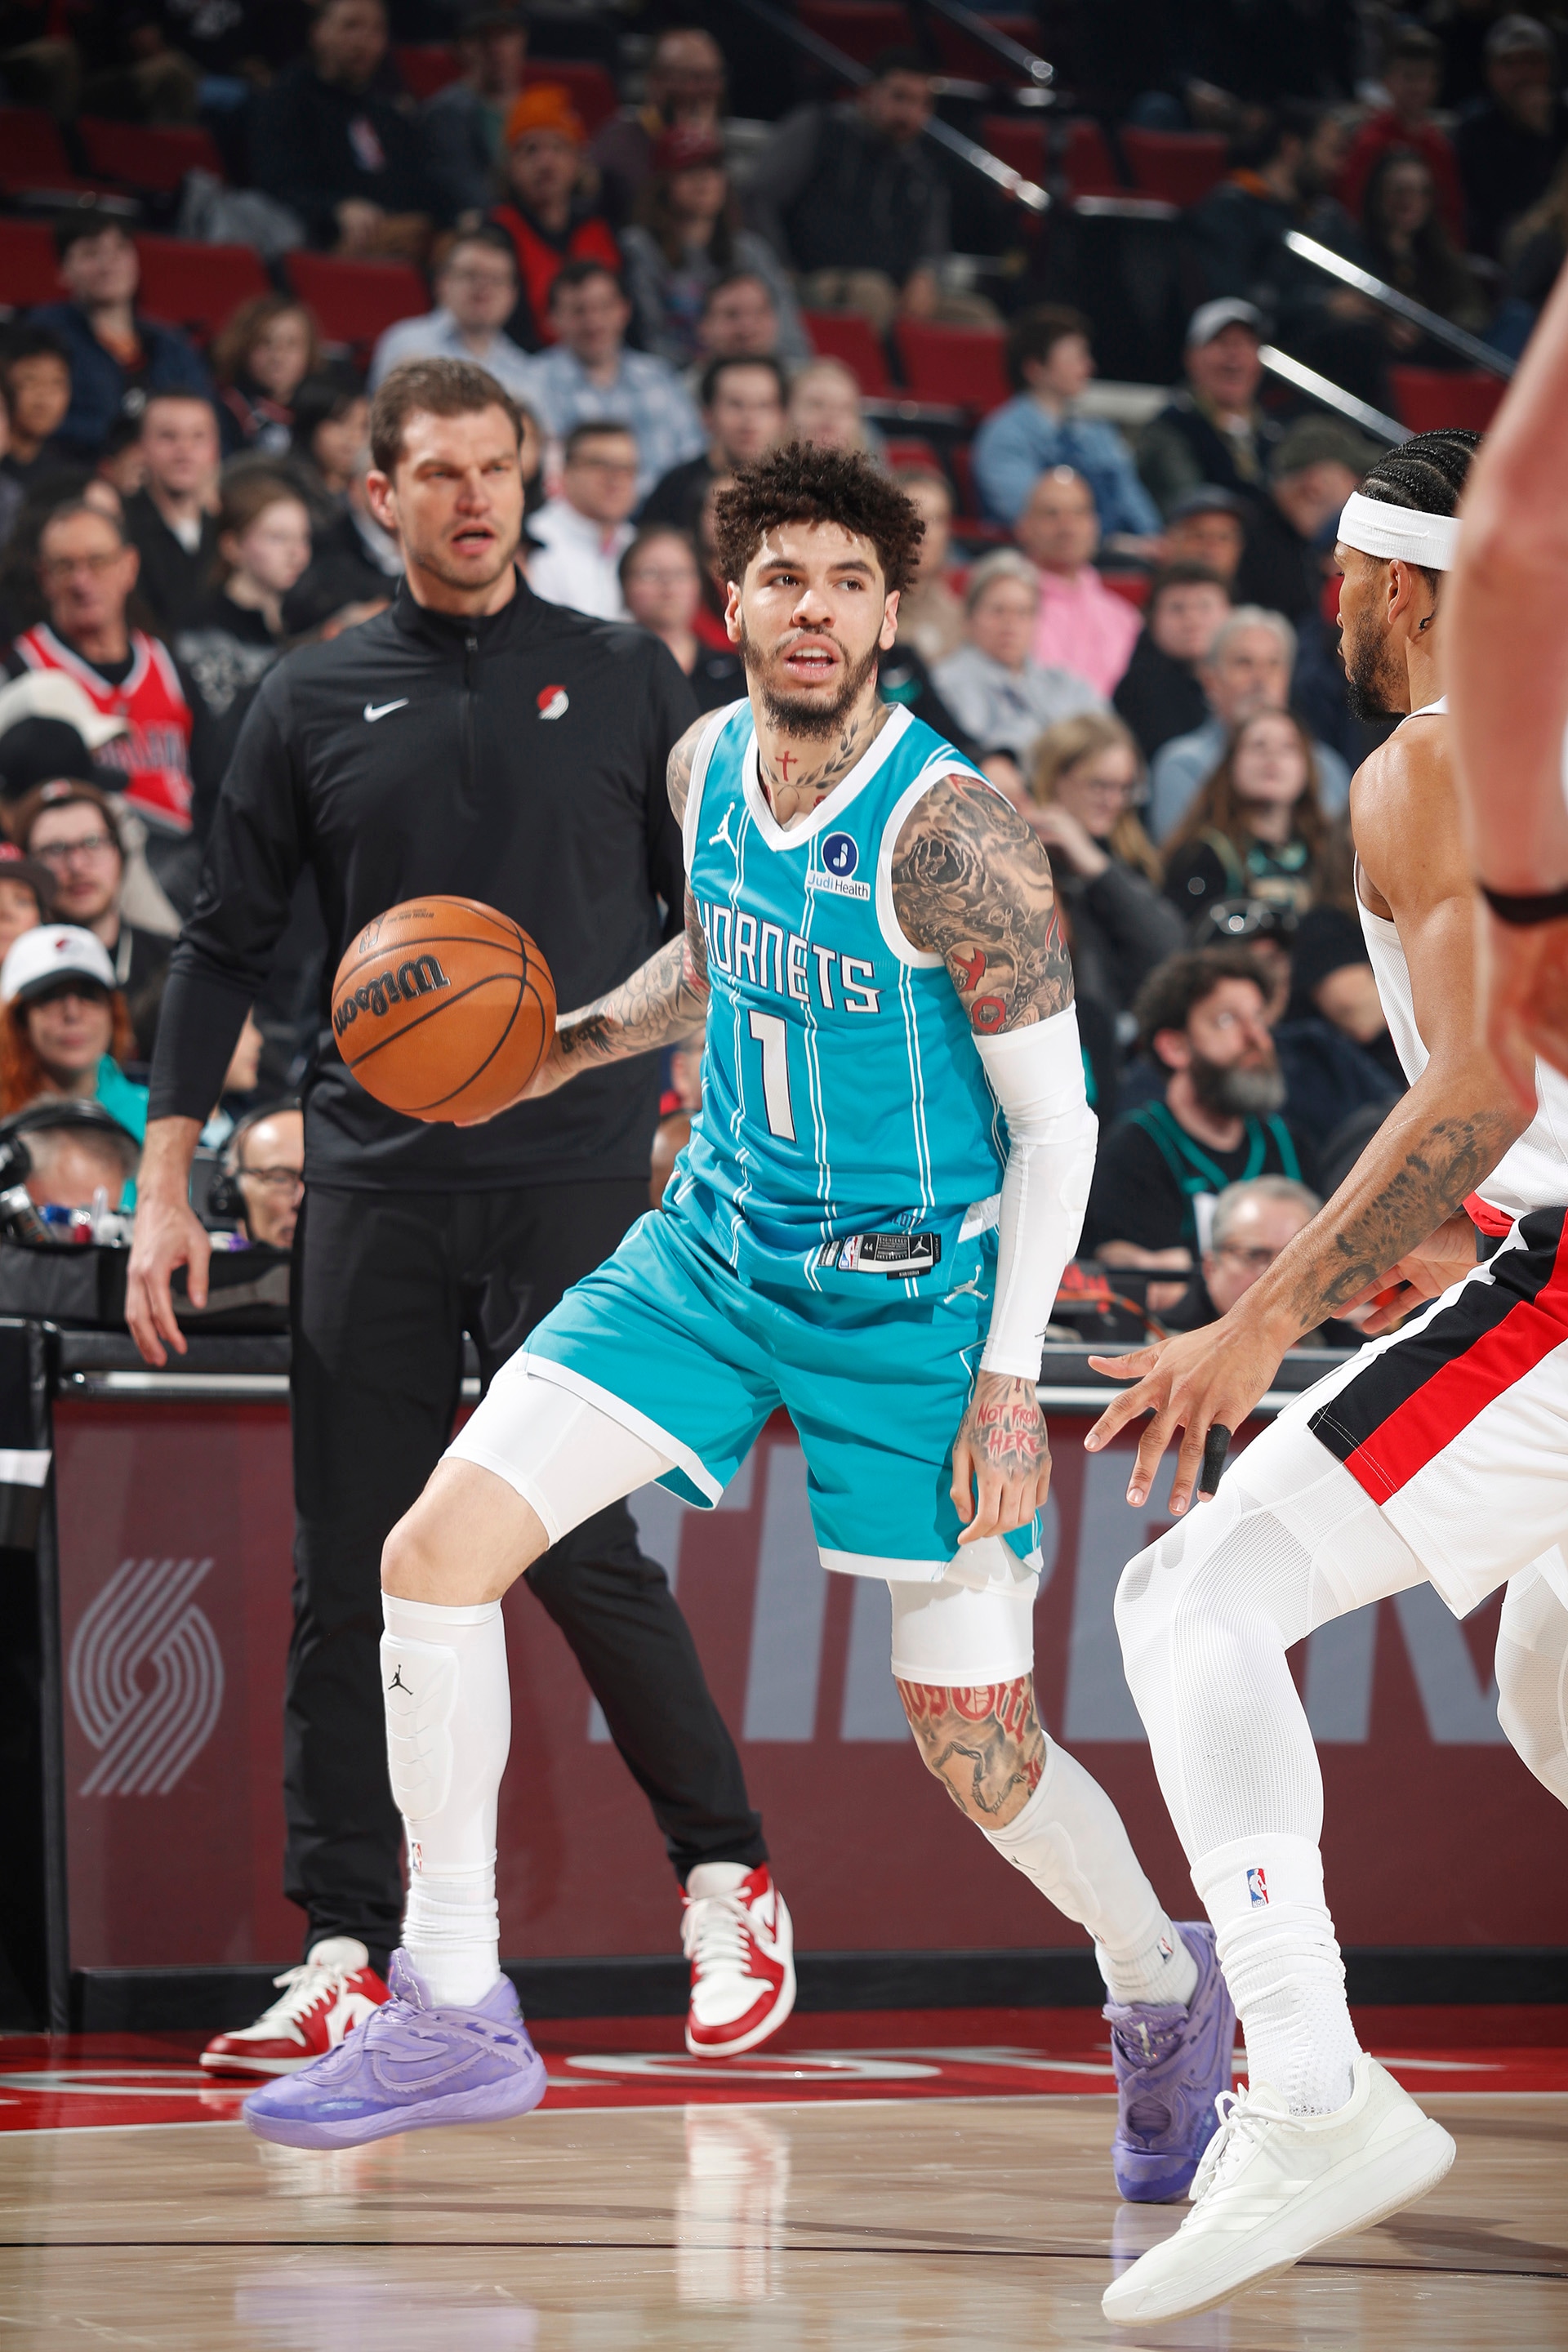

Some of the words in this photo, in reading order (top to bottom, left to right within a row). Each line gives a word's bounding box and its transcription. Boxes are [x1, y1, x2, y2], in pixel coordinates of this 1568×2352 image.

[808, 874, 834, 889] Judi
[835, 880, 868, 898] Health
[696, 899, 886, 1013] HORNETS
[333, 955, 451, 1038] Wilson
[747, 1009, 796, 1143] 1
[864, 1242, 873, 1251] 44
[977, 1402, 1009, 1427] NOT
[1011, 1402, 1039, 1428] FROM
[987, 1429, 1041, 1459] HERE
